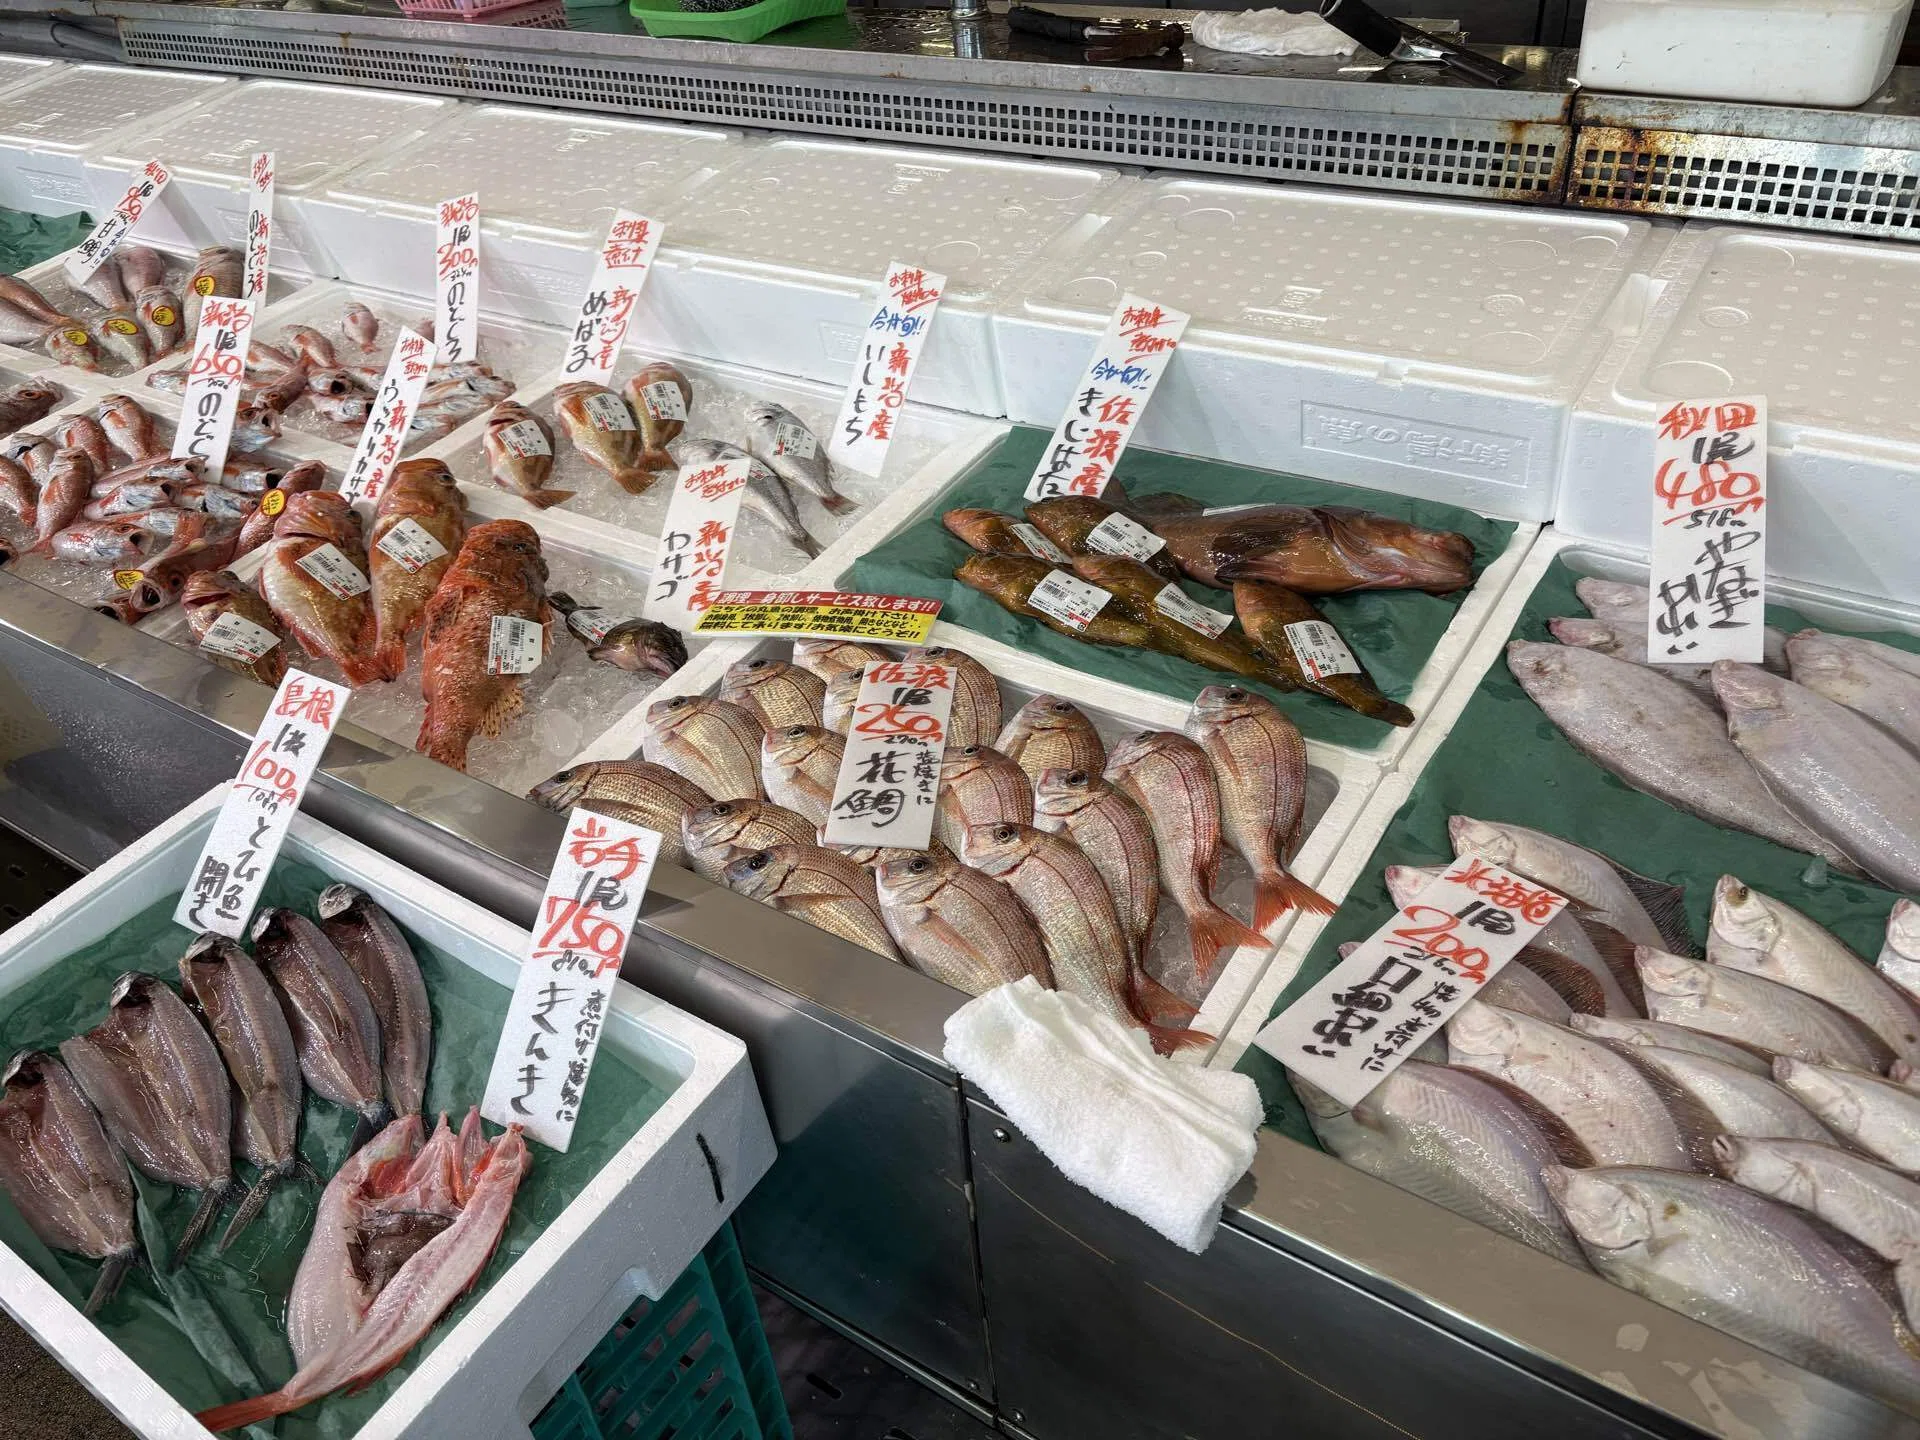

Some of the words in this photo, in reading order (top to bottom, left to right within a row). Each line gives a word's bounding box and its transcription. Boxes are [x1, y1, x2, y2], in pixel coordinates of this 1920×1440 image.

[565, 290, 608, 374] めばる
[846, 344, 886, 446] いしもち
[1657, 401, 1759, 441] 秋田
[1037, 387, 1104, 498] きじはた
[1069, 394, 1137, 497] 佐渡産
[1691, 431, 1756, 465] 1尾
[275, 676, 336, 732] 島根
[866, 662, 955, 690] 佐渡
[891, 686, 935, 707] 1尾
[271, 723, 306, 756] 1枚
[833, 750, 913, 828] 花鯛
[214, 816, 271, 921] とび魚
[568, 817, 649, 881] 岩手
[188, 854, 231, 929] 開き
[574, 869, 628, 912] 1尾
[1453, 900, 1517, 936] 1尾
[510, 981, 576, 1117] きんき
